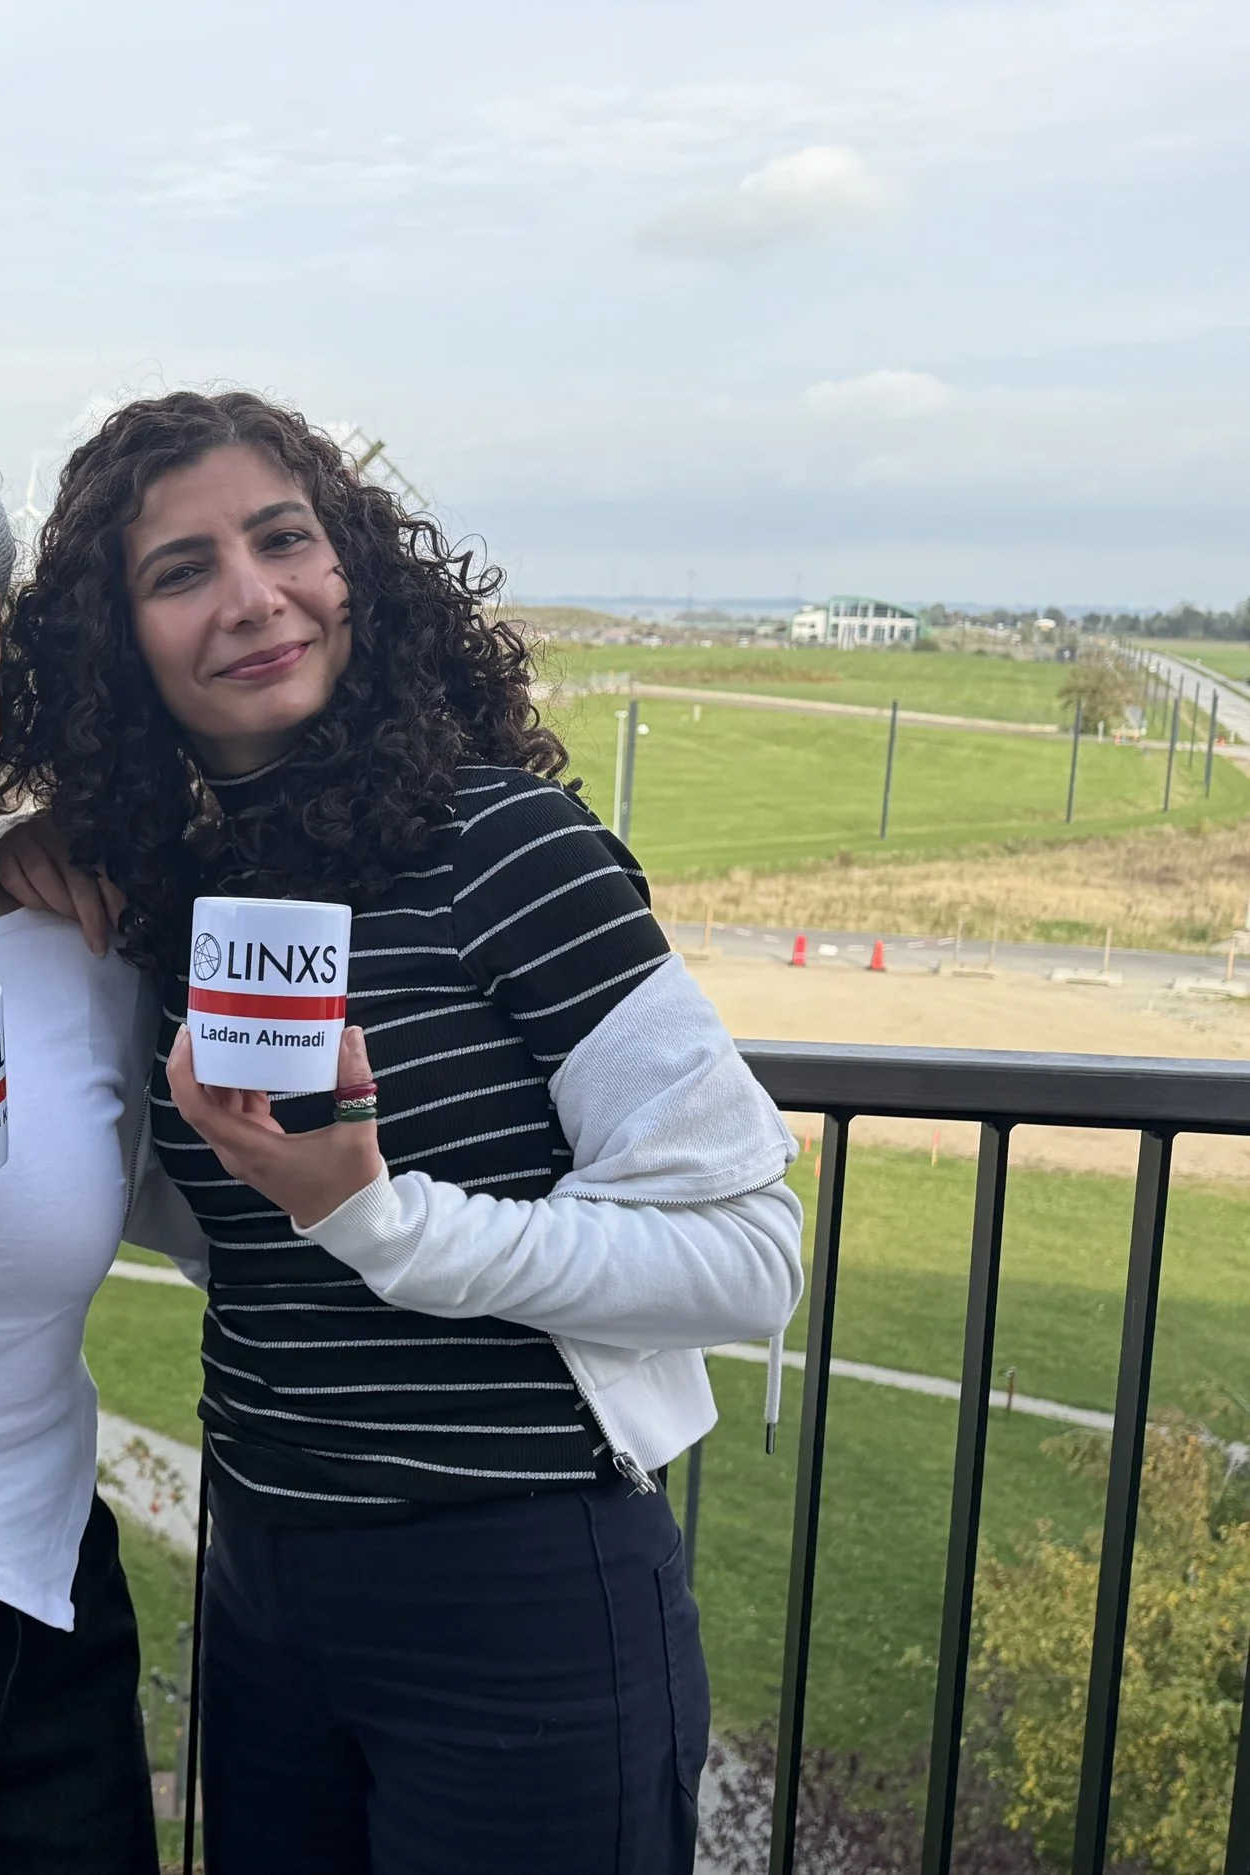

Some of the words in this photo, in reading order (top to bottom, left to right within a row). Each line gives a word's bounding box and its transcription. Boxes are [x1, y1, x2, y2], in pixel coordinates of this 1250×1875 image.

[227, 941, 337, 984] LINXS
[200, 1023, 250, 1044] Ladan
[255, 1029, 325, 1047] Ahmadi
